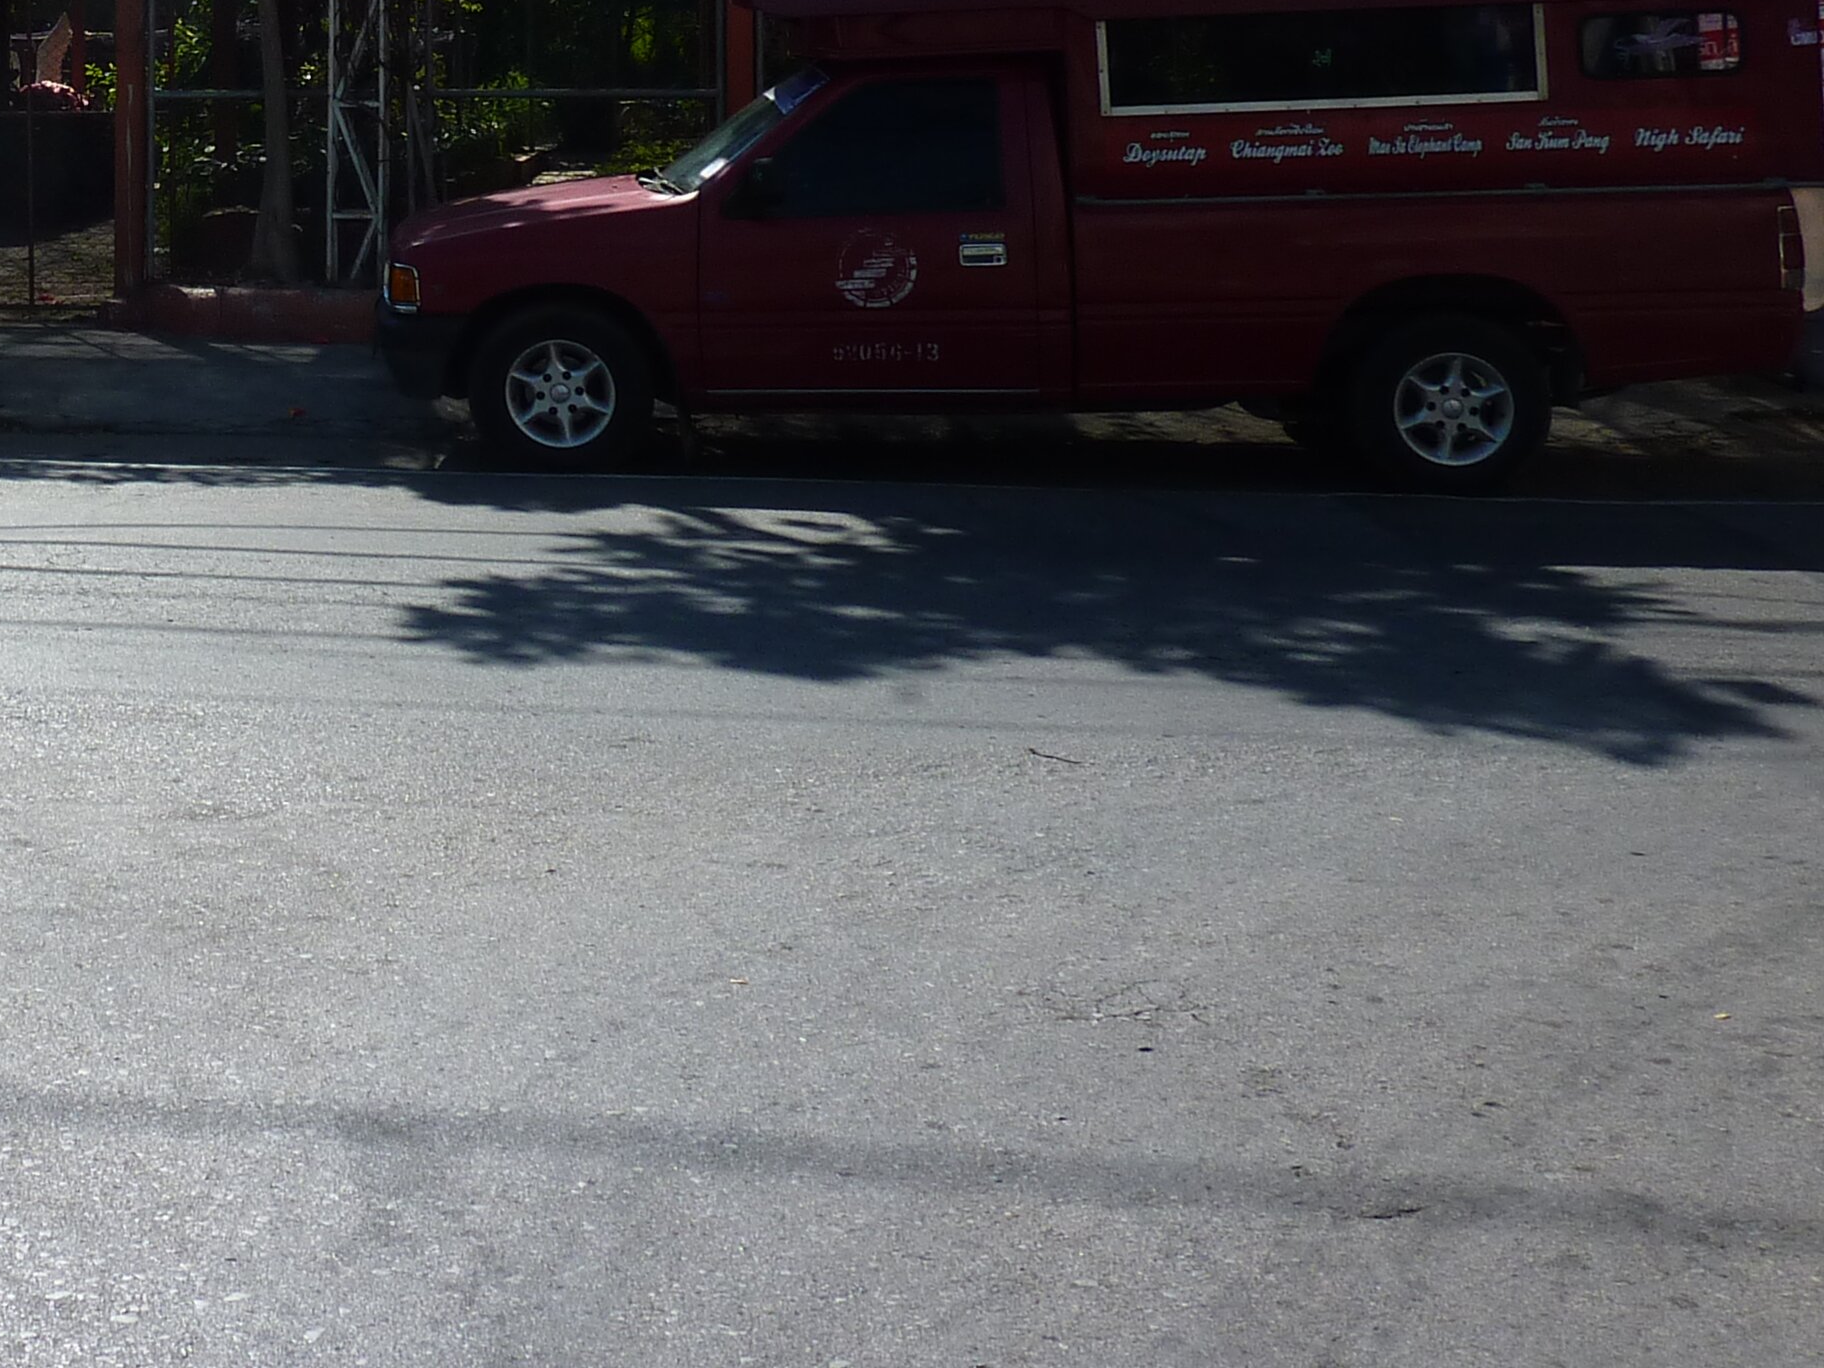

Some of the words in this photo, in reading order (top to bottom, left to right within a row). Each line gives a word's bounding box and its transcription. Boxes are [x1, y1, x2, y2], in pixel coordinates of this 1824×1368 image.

[1230, 137, 1314, 165] Chiangmai
[1317, 136, 1345, 158] Zoo
[1407, 133, 1453, 161] Elephant
[1453, 132, 1484, 160] Camp
[1505, 130, 1533, 152] San
[1572, 128, 1612, 156] Pang
[1684, 125, 1746, 152] Safari
